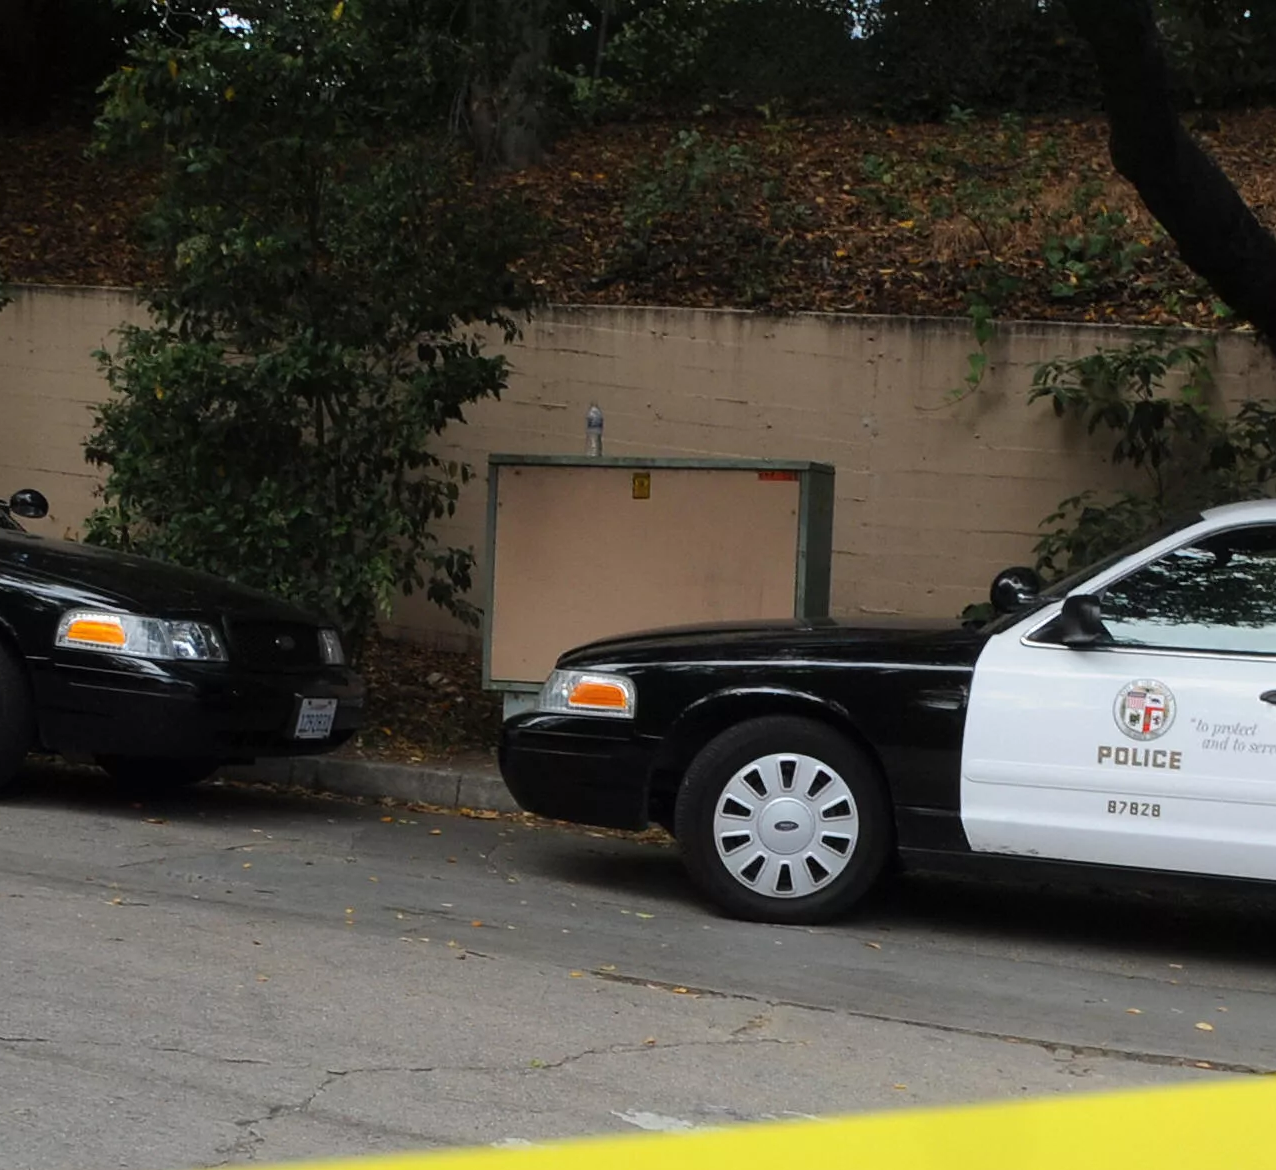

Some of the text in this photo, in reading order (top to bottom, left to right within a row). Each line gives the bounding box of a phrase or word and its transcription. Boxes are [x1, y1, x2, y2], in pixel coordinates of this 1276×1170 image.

[1211, 722, 1257, 737] protect
[1202, 736, 1230, 751] and
[1233, 738, 1246, 752] to
[1097, 745, 1182, 770] POLICE
[1107, 800, 1161, 818] 87828
